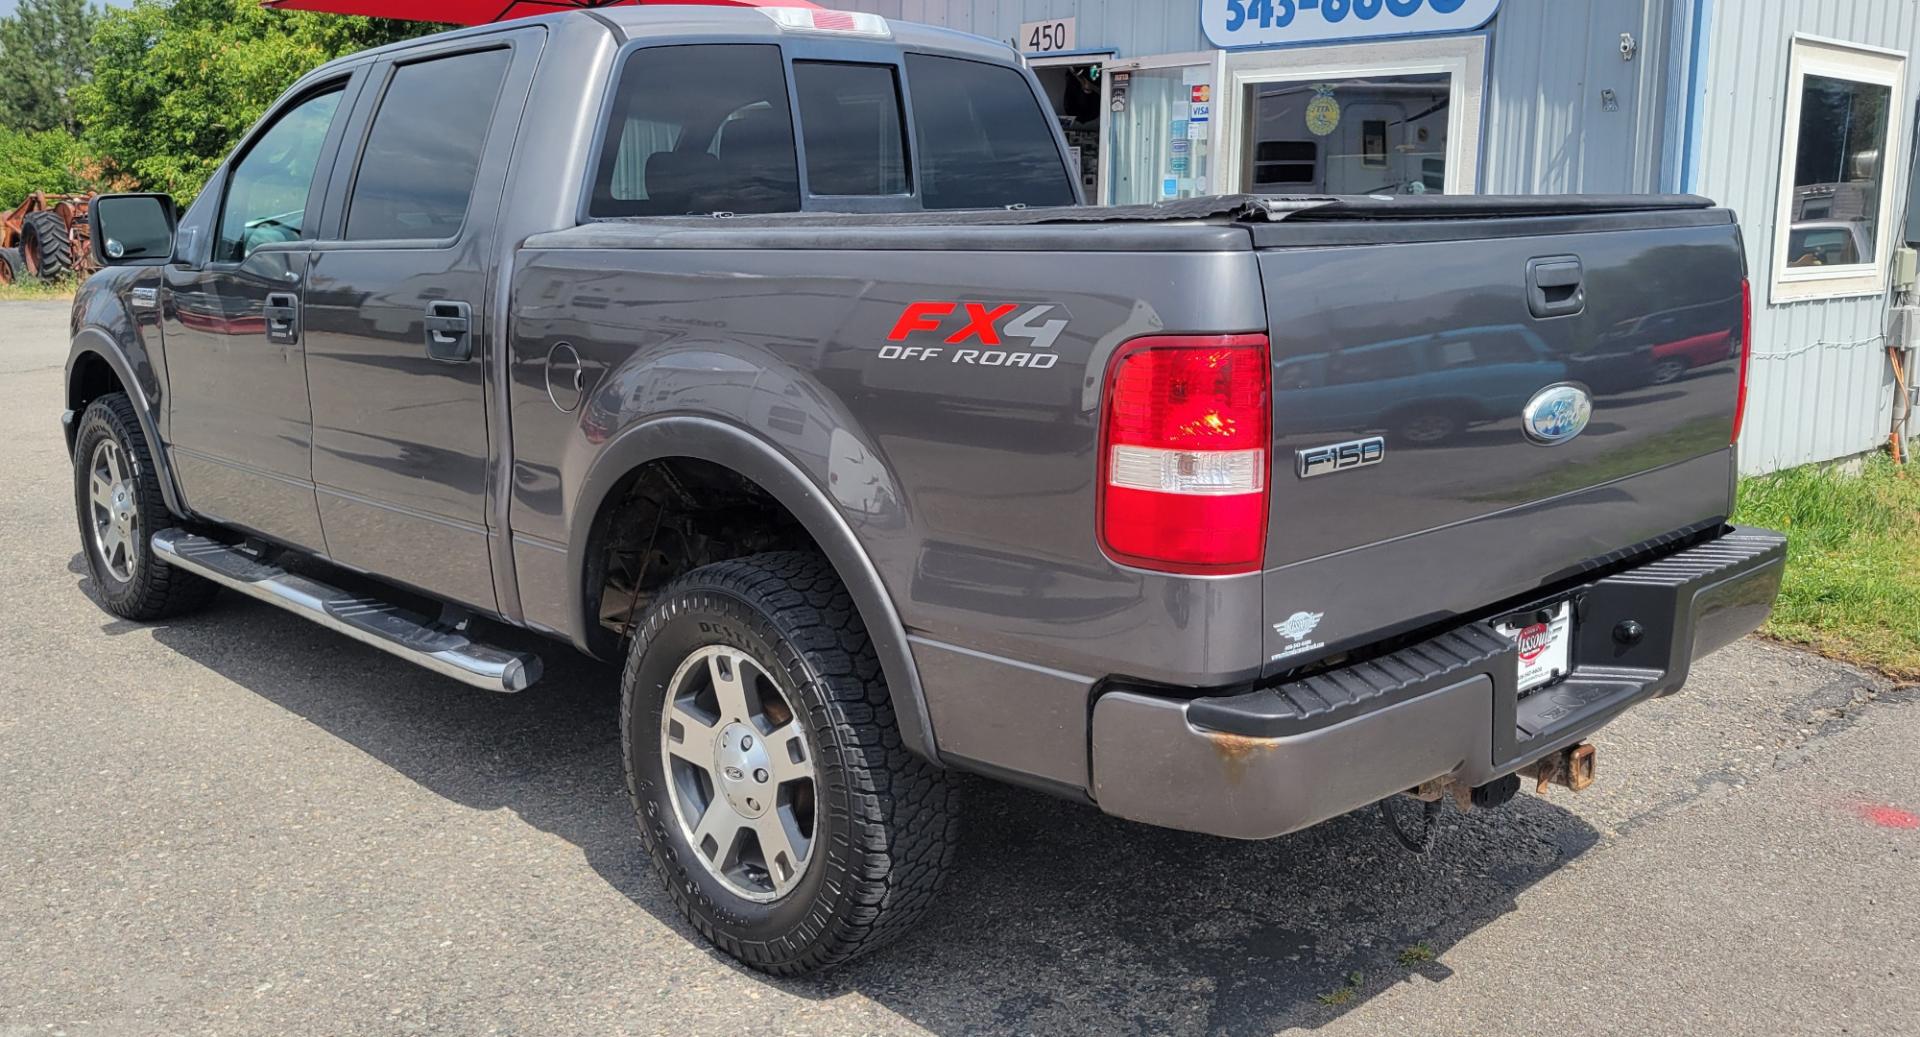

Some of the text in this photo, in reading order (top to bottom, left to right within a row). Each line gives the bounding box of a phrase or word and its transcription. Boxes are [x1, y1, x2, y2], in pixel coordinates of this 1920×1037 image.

[1029, 23, 1065, 52] 450
[1193, 106, 1209, 115] VISA
[886, 302, 1069, 348] FX4
[878, 345, 1059, 369] OFF ROAD
[1303, 440, 1383, 475] F-150
